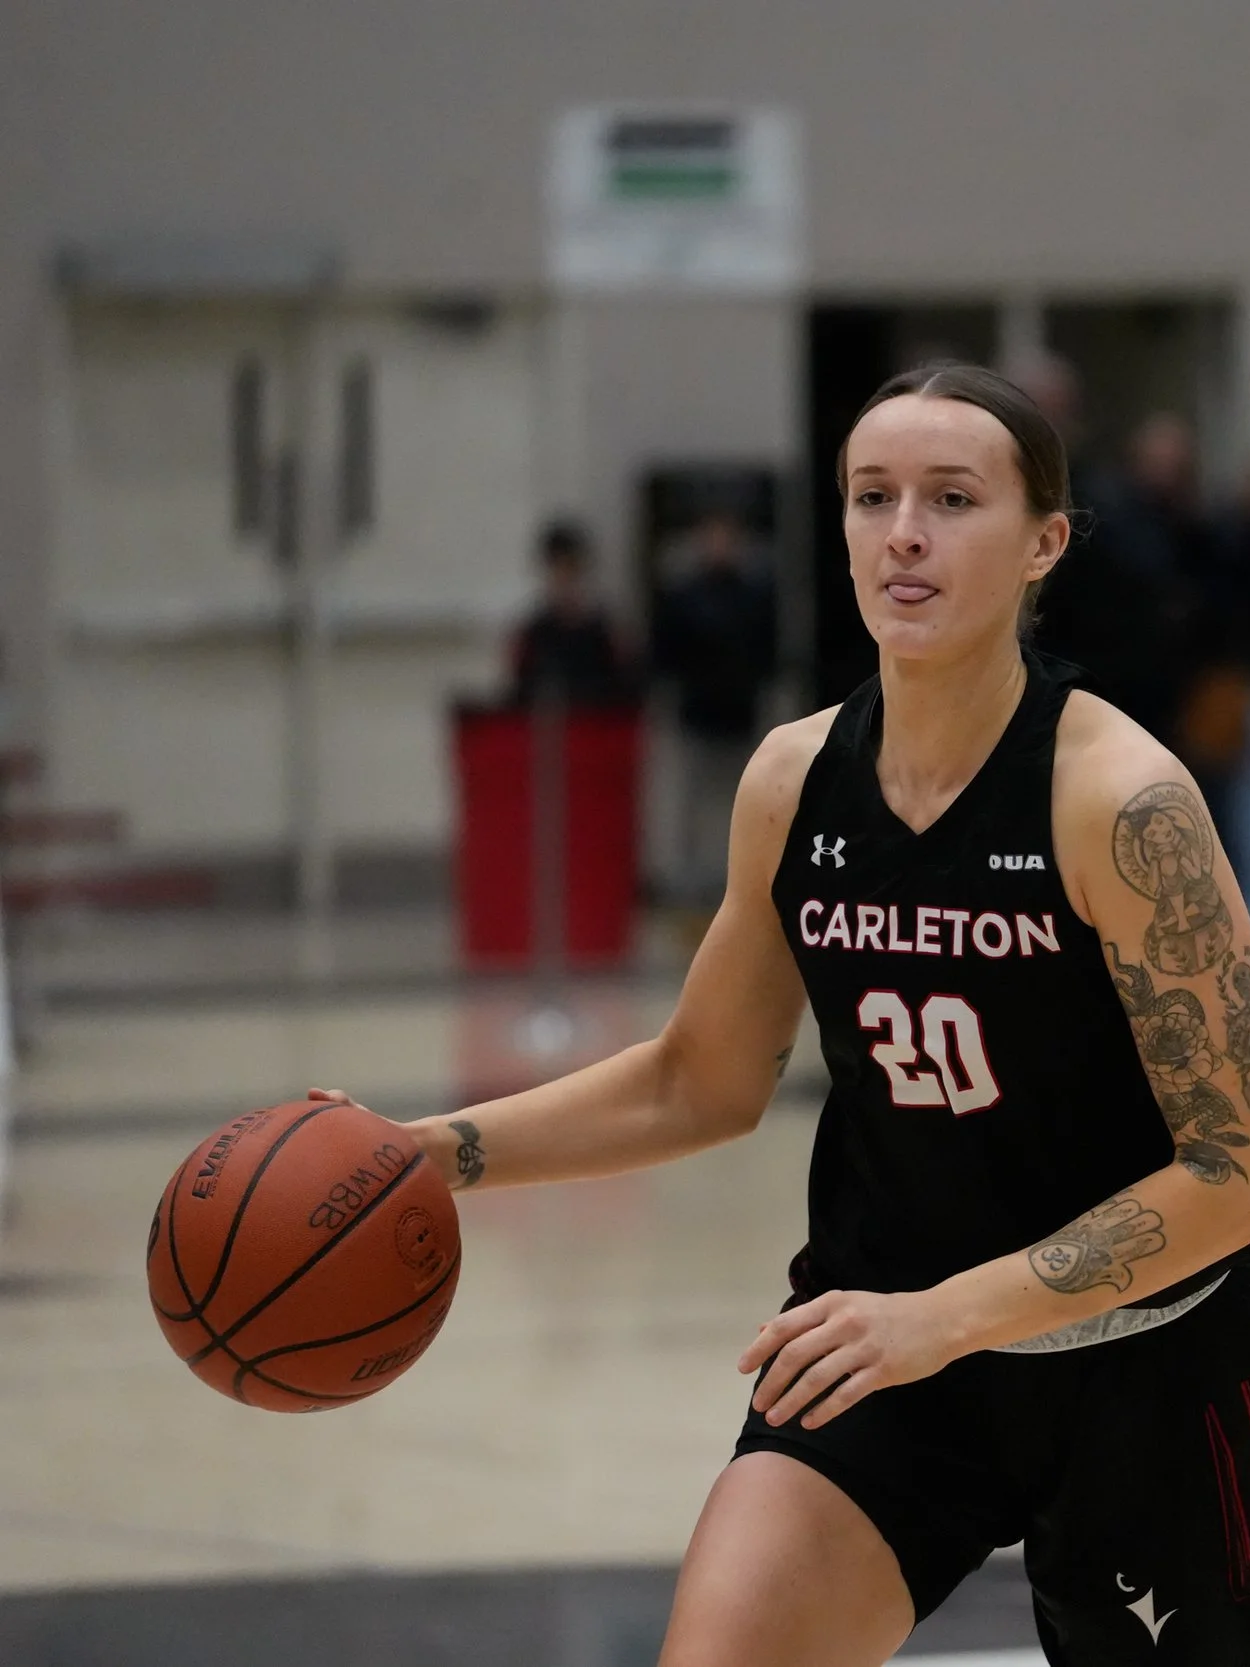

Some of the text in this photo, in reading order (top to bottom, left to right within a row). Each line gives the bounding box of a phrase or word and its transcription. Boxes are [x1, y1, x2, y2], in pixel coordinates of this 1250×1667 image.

[988, 854, 1046, 870] OUA
[799, 899, 1061, 958] CARLETON
[856, 988, 1003, 1118] 20
[309, 1168, 383, 1230] WBB
